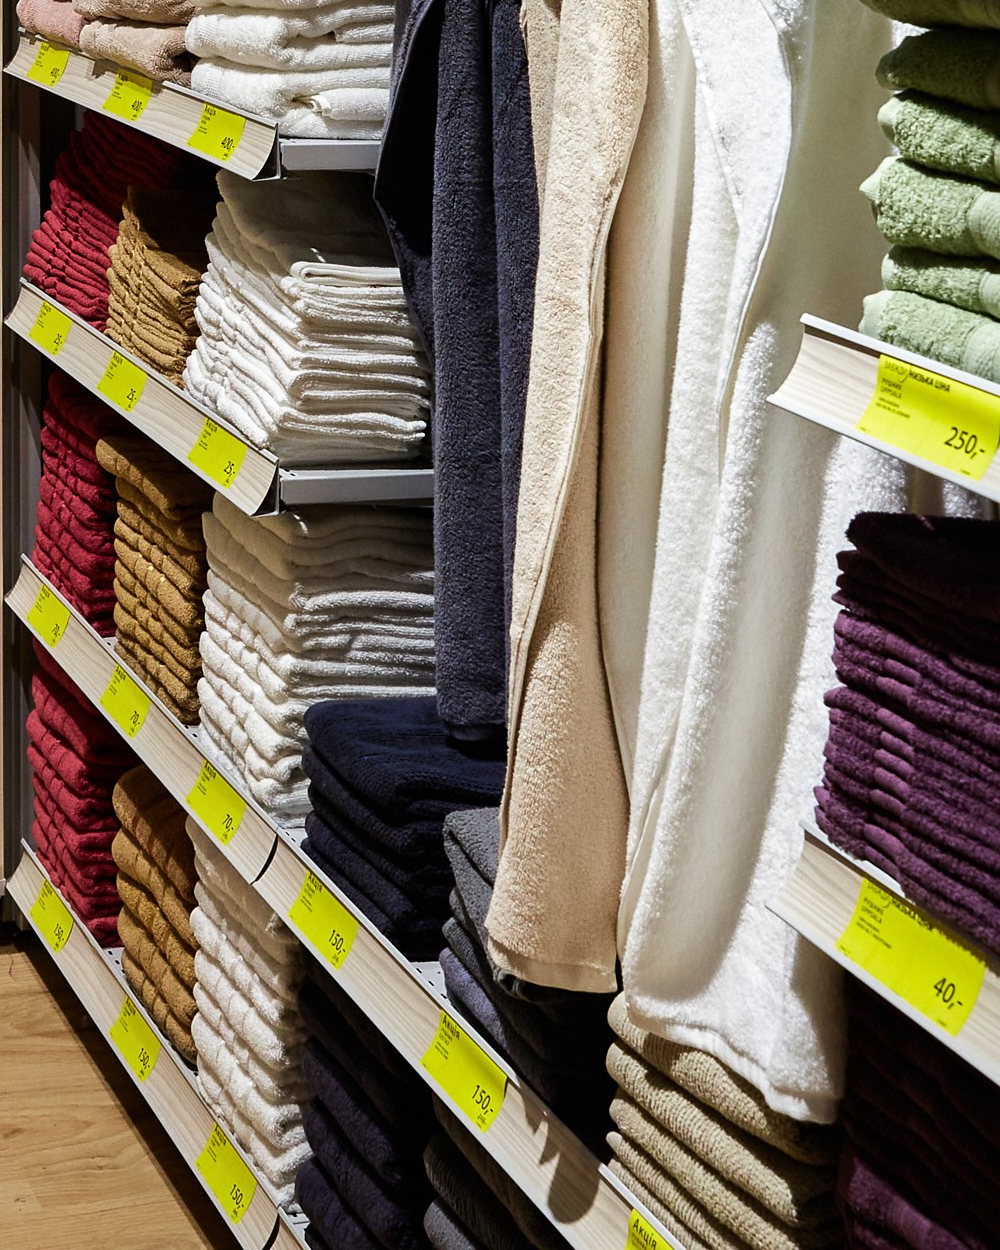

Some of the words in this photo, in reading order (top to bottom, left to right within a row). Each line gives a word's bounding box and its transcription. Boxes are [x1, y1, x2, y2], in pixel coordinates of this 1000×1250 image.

[944, 426, 986, 460] 250,-
[129, 709, 141, 727] 70,-
[221, 813, 235, 832] 70,-
[328, 928, 347, 956] 150,-
[933, 977, 963, 1010] 40,-
[441, 1013, 461, 1041] Акція
[137, 1047, 151, 1070] 150,-
[471, 1084, 494, 1116] 150,-
[229, 1183, 245, 1210] 150,-
[632, 1218, 657, 1250] Акція
